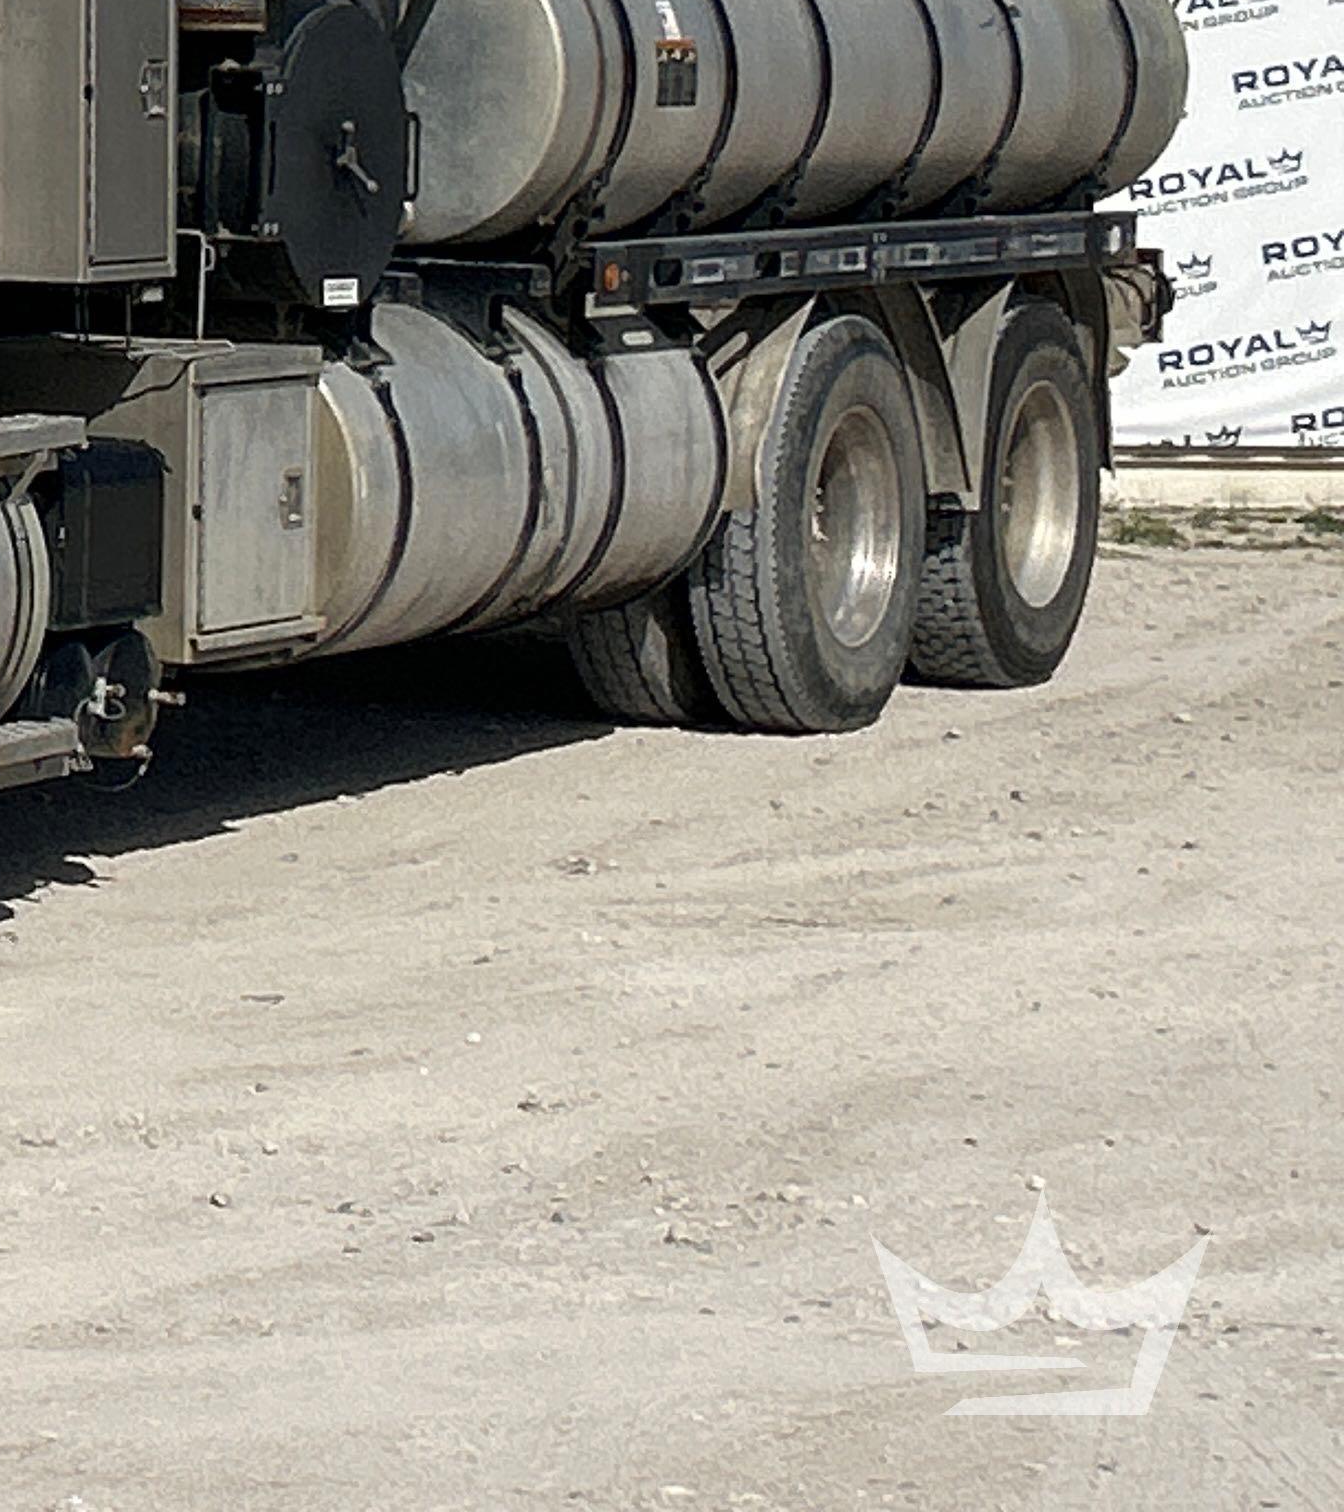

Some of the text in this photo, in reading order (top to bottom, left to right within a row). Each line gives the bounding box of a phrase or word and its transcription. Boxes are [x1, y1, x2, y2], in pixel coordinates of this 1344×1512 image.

[1201, 3, 1279, 29] GROUP
[1232, 54, 1344, 95] ROYA
[1238, 83, 1333, 112] AUCTION
[1129, 159, 1268, 201] ROYAL
[1136, 175, 1309, 218] AUCTION GROUP
[1261, 230, 1344, 266] ROY
[1158, 329, 1296, 373] ROYAL
[1162, 345, 1337, 389] AUCTION GROUP
